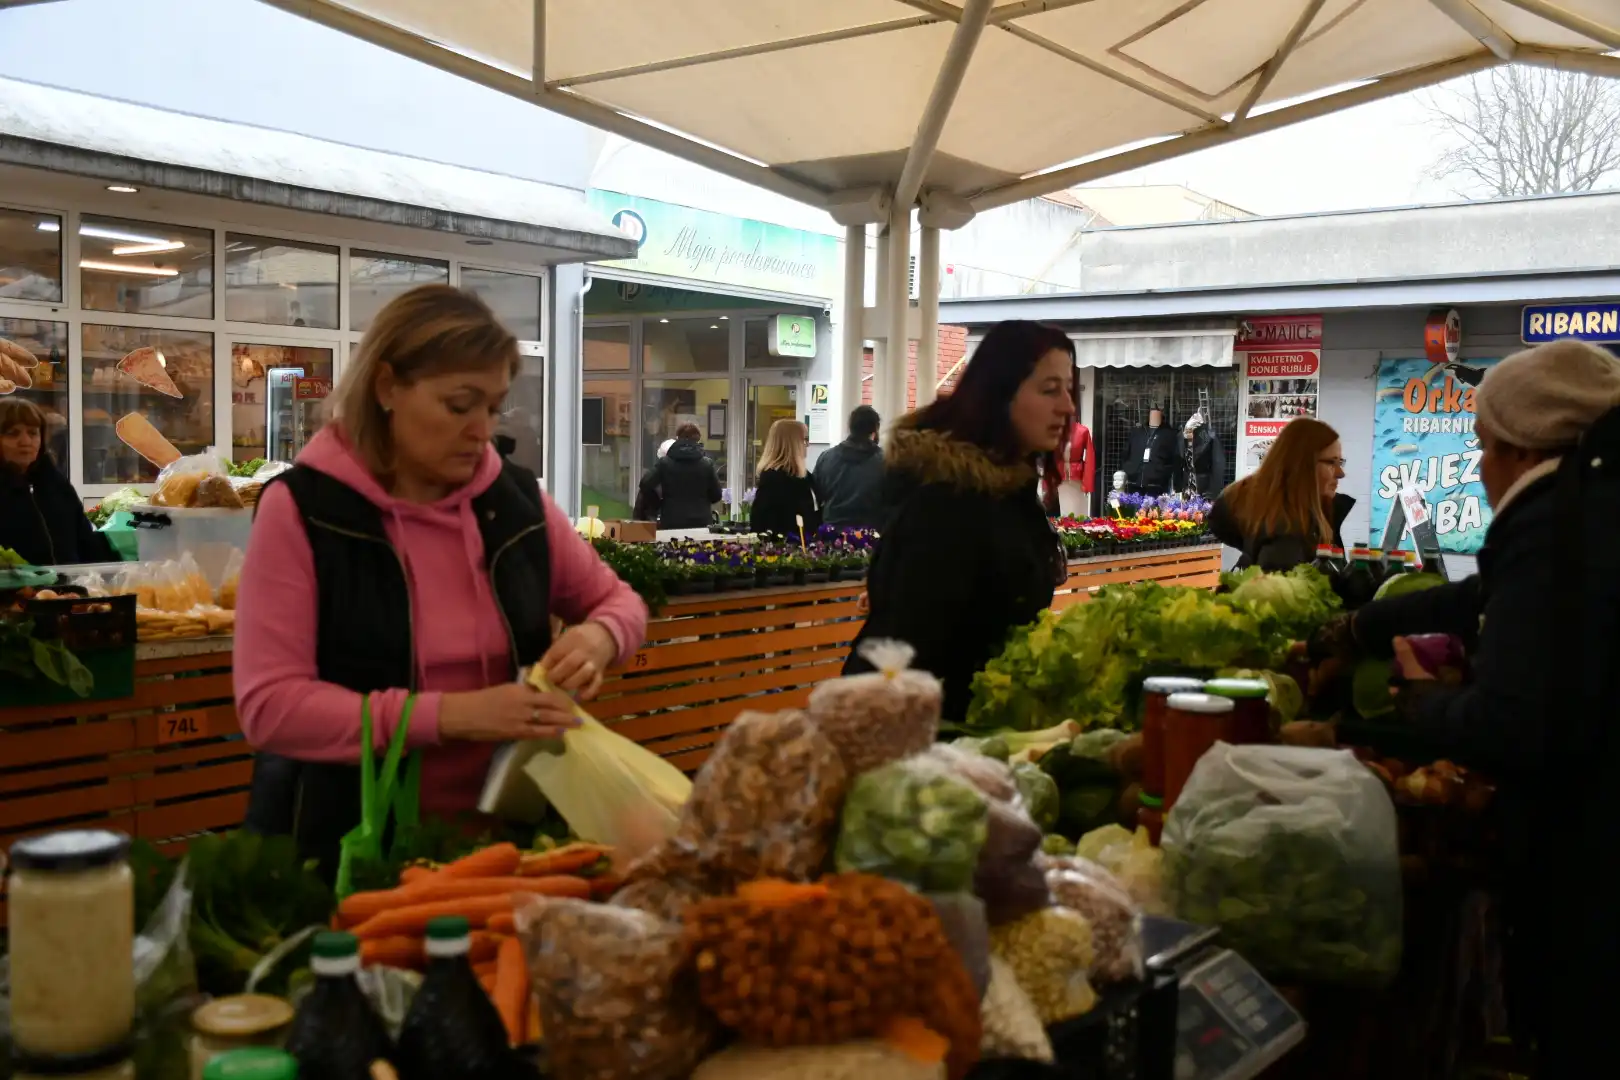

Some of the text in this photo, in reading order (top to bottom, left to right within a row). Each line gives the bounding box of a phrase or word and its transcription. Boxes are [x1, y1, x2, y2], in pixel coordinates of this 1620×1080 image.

[664, 224, 717, 273] Moja
[1529, 310, 1620, 335] RIBARN
[1265, 324, 1313, 340] MAJICE
[1250, 354, 1304, 365] KVALITETNO
[1250, 364, 1312, 374] DONJE RUBLJE
[1403, 375, 1477, 414] Orka
[1249, 425, 1277, 434] ŽENSKA
[635, 653, 648, 666] 75
[167, 717, 199, 737] 74L
